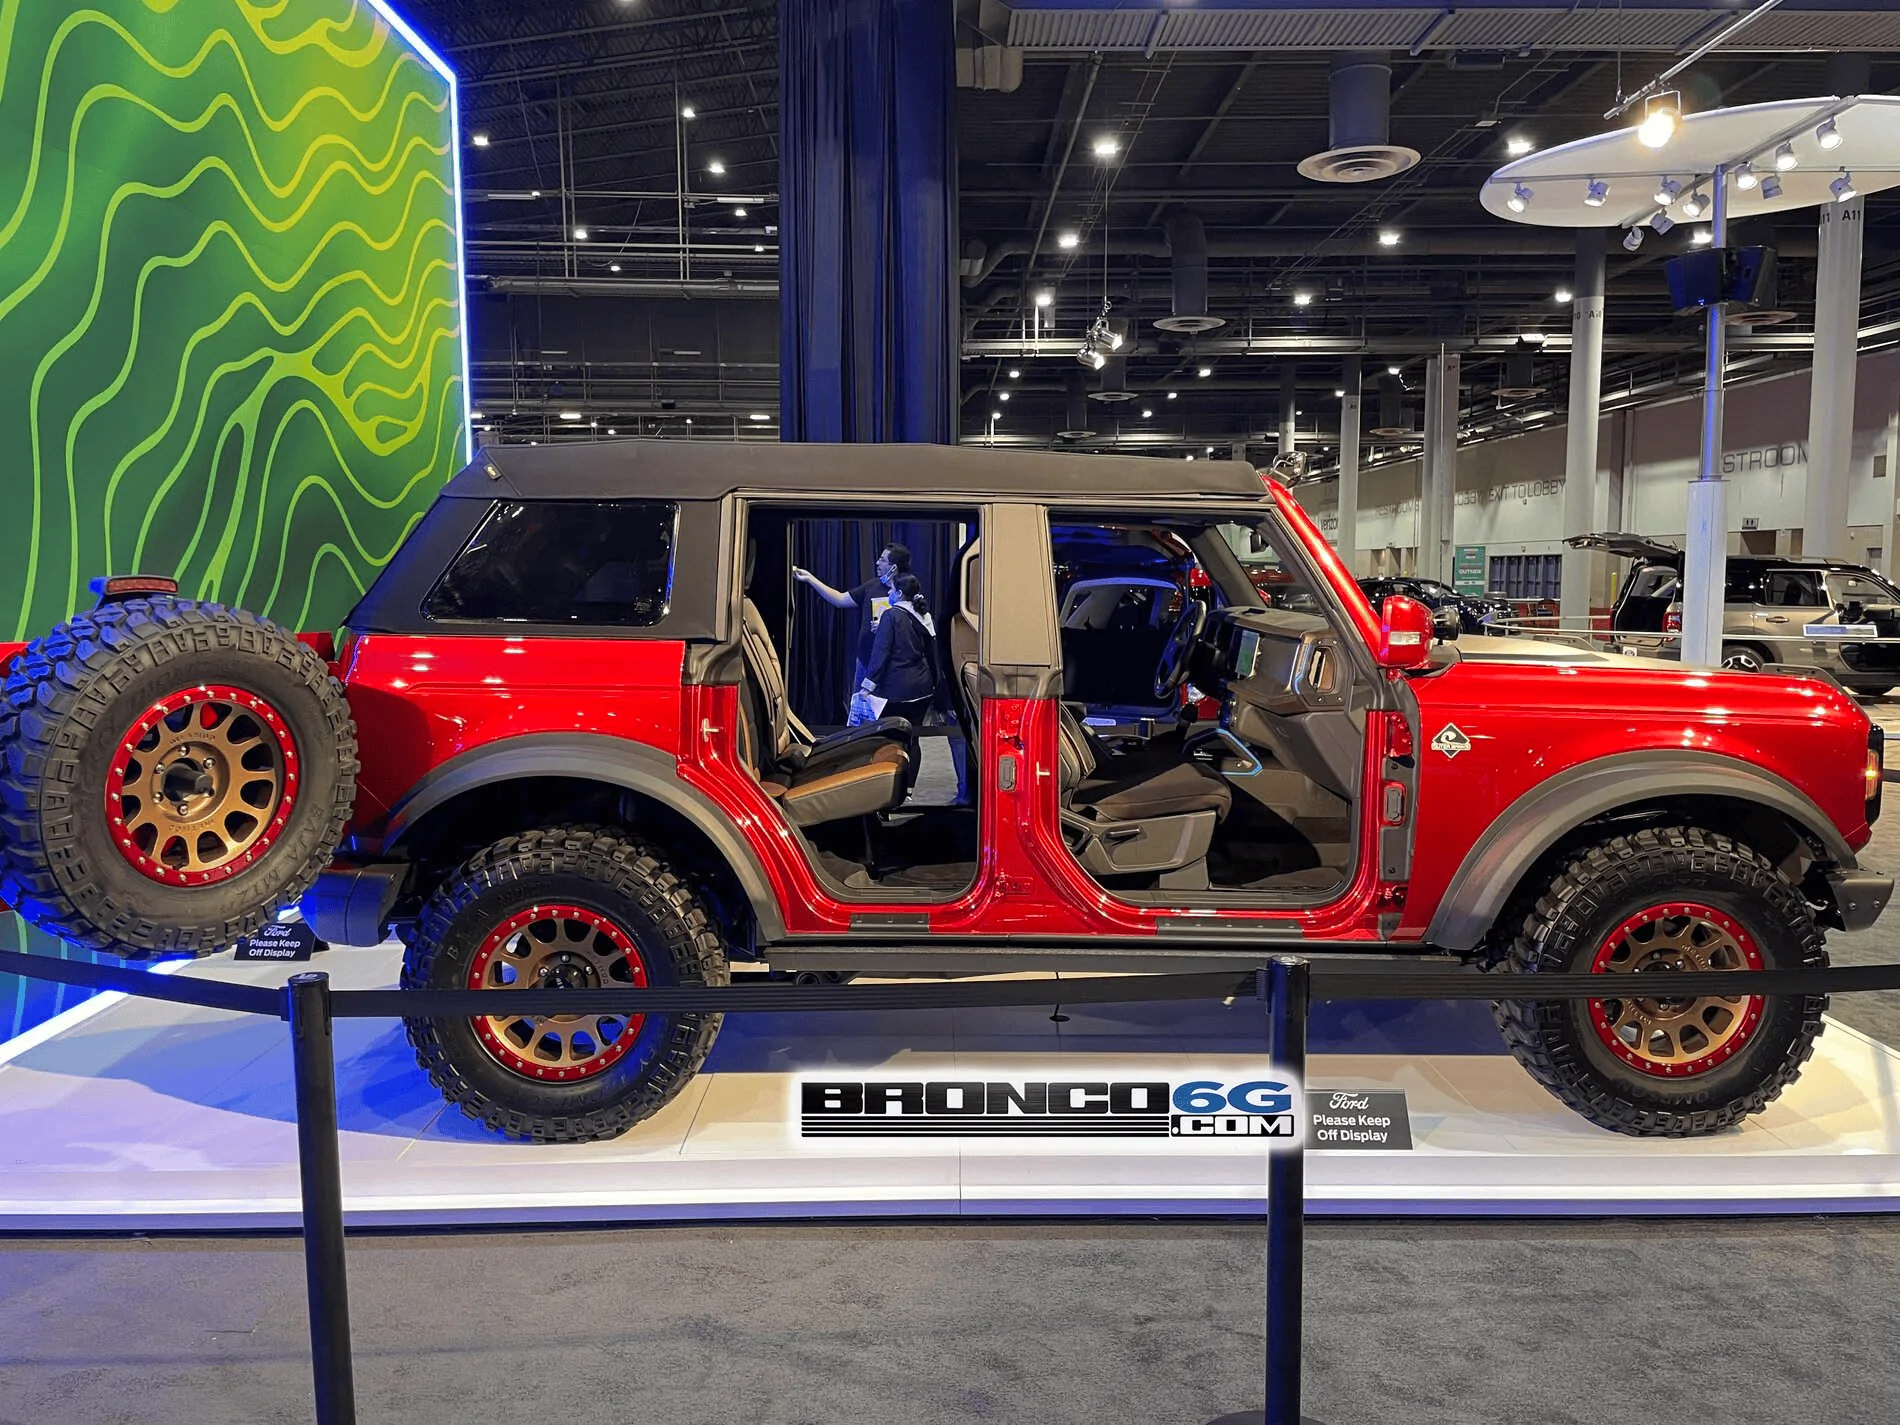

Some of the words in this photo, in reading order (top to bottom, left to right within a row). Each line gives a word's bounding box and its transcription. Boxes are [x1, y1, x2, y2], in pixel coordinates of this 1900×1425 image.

[1841, 209, 1861, 221] A11
[1527, 478, 1566, 498] LOBBY
[1320, 513, 1339, 531] verizo
[263, 925, 292, 937] Ford
[249, 939, 278, 947] Please
[278, 939, 301, 949] Keep
[248, 948, 263, 957] Off
[263, 949, 296, 958] Display
[1329, 1092, 1369, 1110] Ford
[1313, 1114, 1356, 1126] Please
[1358, 1114, 1391, 1128] Keep
[1317, 1129, 1338, 1141] Off
[1339, 1129, 1388, 1143] Display
